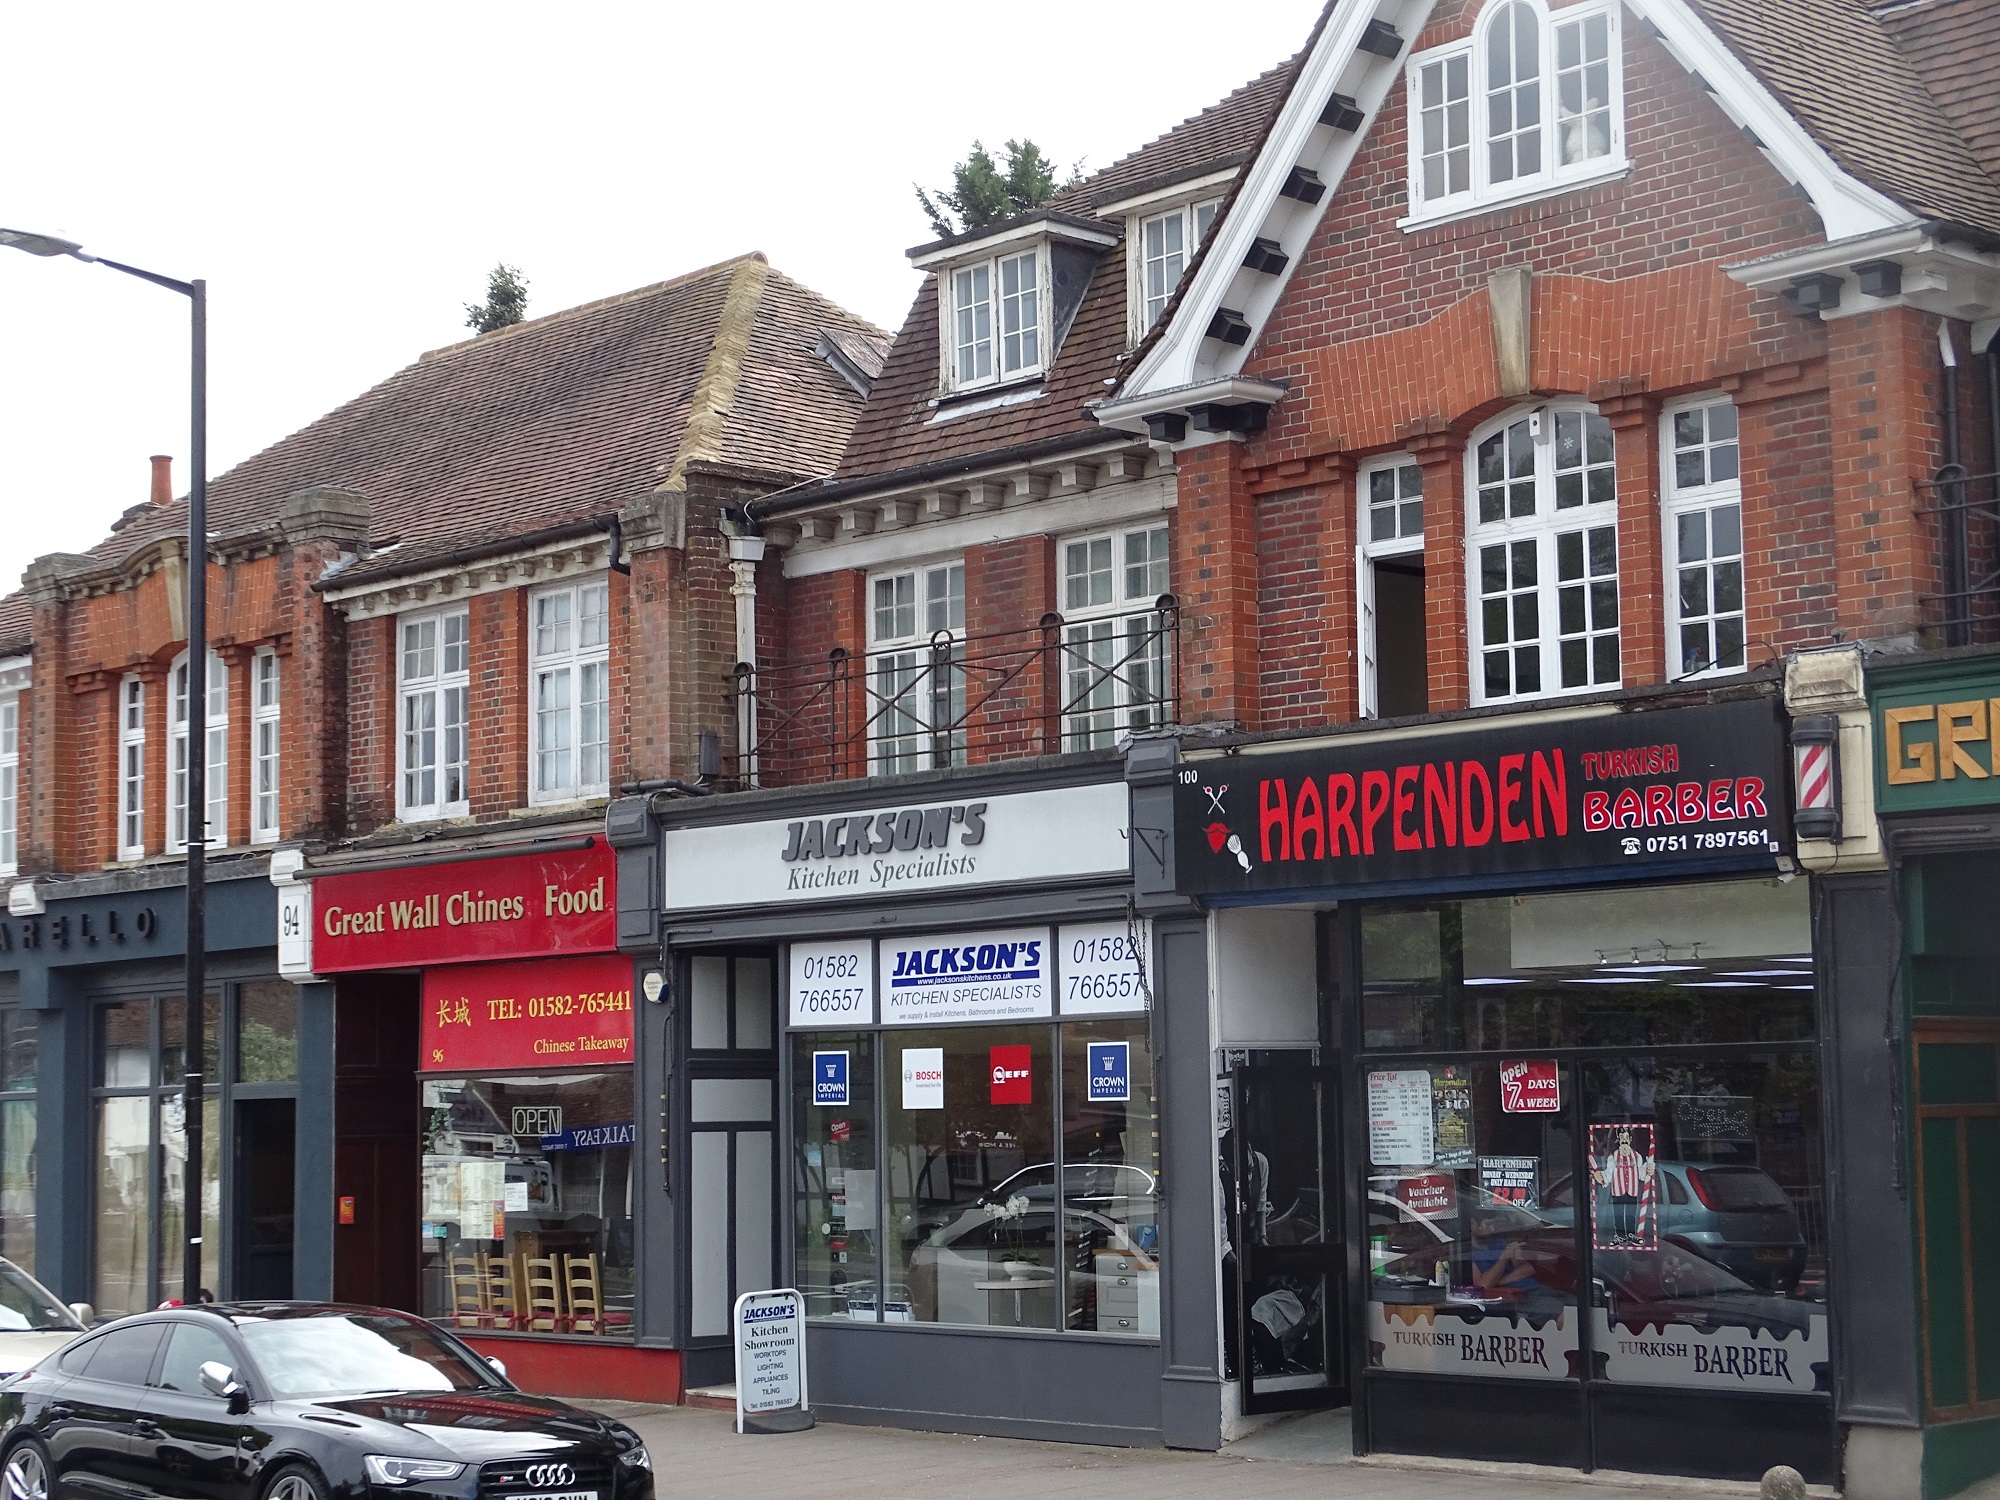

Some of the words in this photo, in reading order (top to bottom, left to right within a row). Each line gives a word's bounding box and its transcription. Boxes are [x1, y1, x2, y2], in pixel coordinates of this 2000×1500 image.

[1885, 698, 2000, 785] GR
[1581, 744, 1679, 780] TURKISH
[1178, 770, 1198, 784] 100
[1259, 748, 1568, 862] HARPENDEN
[1583, 776, 1767, 832] BARBER
[781, 803, 988, 862] JACKSON'S
[1646, 835, 1688, 853] 0751
[1694, 829, 1768, 850] 7897561
[787, 864, 859, 890] Kitchen
[870, 853, 976, 888] Specialists
[324, 906, 385, 937] Great
[389, 894, 440, 931] Wall
[445, 889, 524, 926] Chines
[545, 876, 604, 917] Food
[284, 905, 299, 936] 94
[892, 941, 1041, 976] JACKSON'S
[1073, 935, 1136, 963] 01582
[804, 954, 858, 979] 01582
[917, 972, 1012, 985] www.jacksonskitchens.co.uk
[1068, 973, 1142, 1000] 766557
[487, 999, 522, 1021] TEL:
[528, 990, 632, 1018] 01582-765441
[799, 988, 863, 1012] 766557
[890, 991, 949, 1007] KITCHEN
[953, 985, 1042, 1003] SPECIALISTS
[435, 996, 471, 1028] 长城
[908, 1011, 923, 1020] supply
[929, 1010, 943, 1018] install
[968, 1007, 995, 1016] Bathrooms
[1007, 1005, 1034, 1014] Bedrooms
[432, 1049, 444, 1063] 96
[533, 1037, 575, 1054] Chinese
[577, 1036, 629, 1053] Takeaway
[916, 1071, 941, 1081] BOSCH
[1093, 1076, 1124, 1087] CROWN
[1501, 1061, 1528, 1084] OPEN
[817, 1083, 844, 1093] CROWN
[1507, 1081, 1522, 1110] 7
[1528, 1079, 1555, 1089] DAYS
[1527, 1098, 1557, 1108] WEEK
[514, 1109, 560, 1134] OPEN
[831, 1121, 846, 1133] Open
[1482, 1159, 1533, 1168] HARPENDEN
[1408, 1185, 1445, 1197] Voucher
[1407, 1196, 1448, 1209] Available
[744, 1304, 795, 1319] JACKSON'S
[751, 1326, 788, 1338] Kitchen
[744, 1337, 795, 1351] Showroom
[754, 1350, 786, 1359] WORKTOPS
[1393, 1331, 1456, 1347] TURKISH
[1460, 1334, 1550, 1371] BARBER
[757, 1362, 783, 1371] LIGHTING
[1618, 1341, 1688, 1357] TURKISH
[1694, 1344, 1793, 1384] BARBER
[753, 1374, 788, 1384] APPLIANCES
[762, 1387, 780, 1396] TILING
